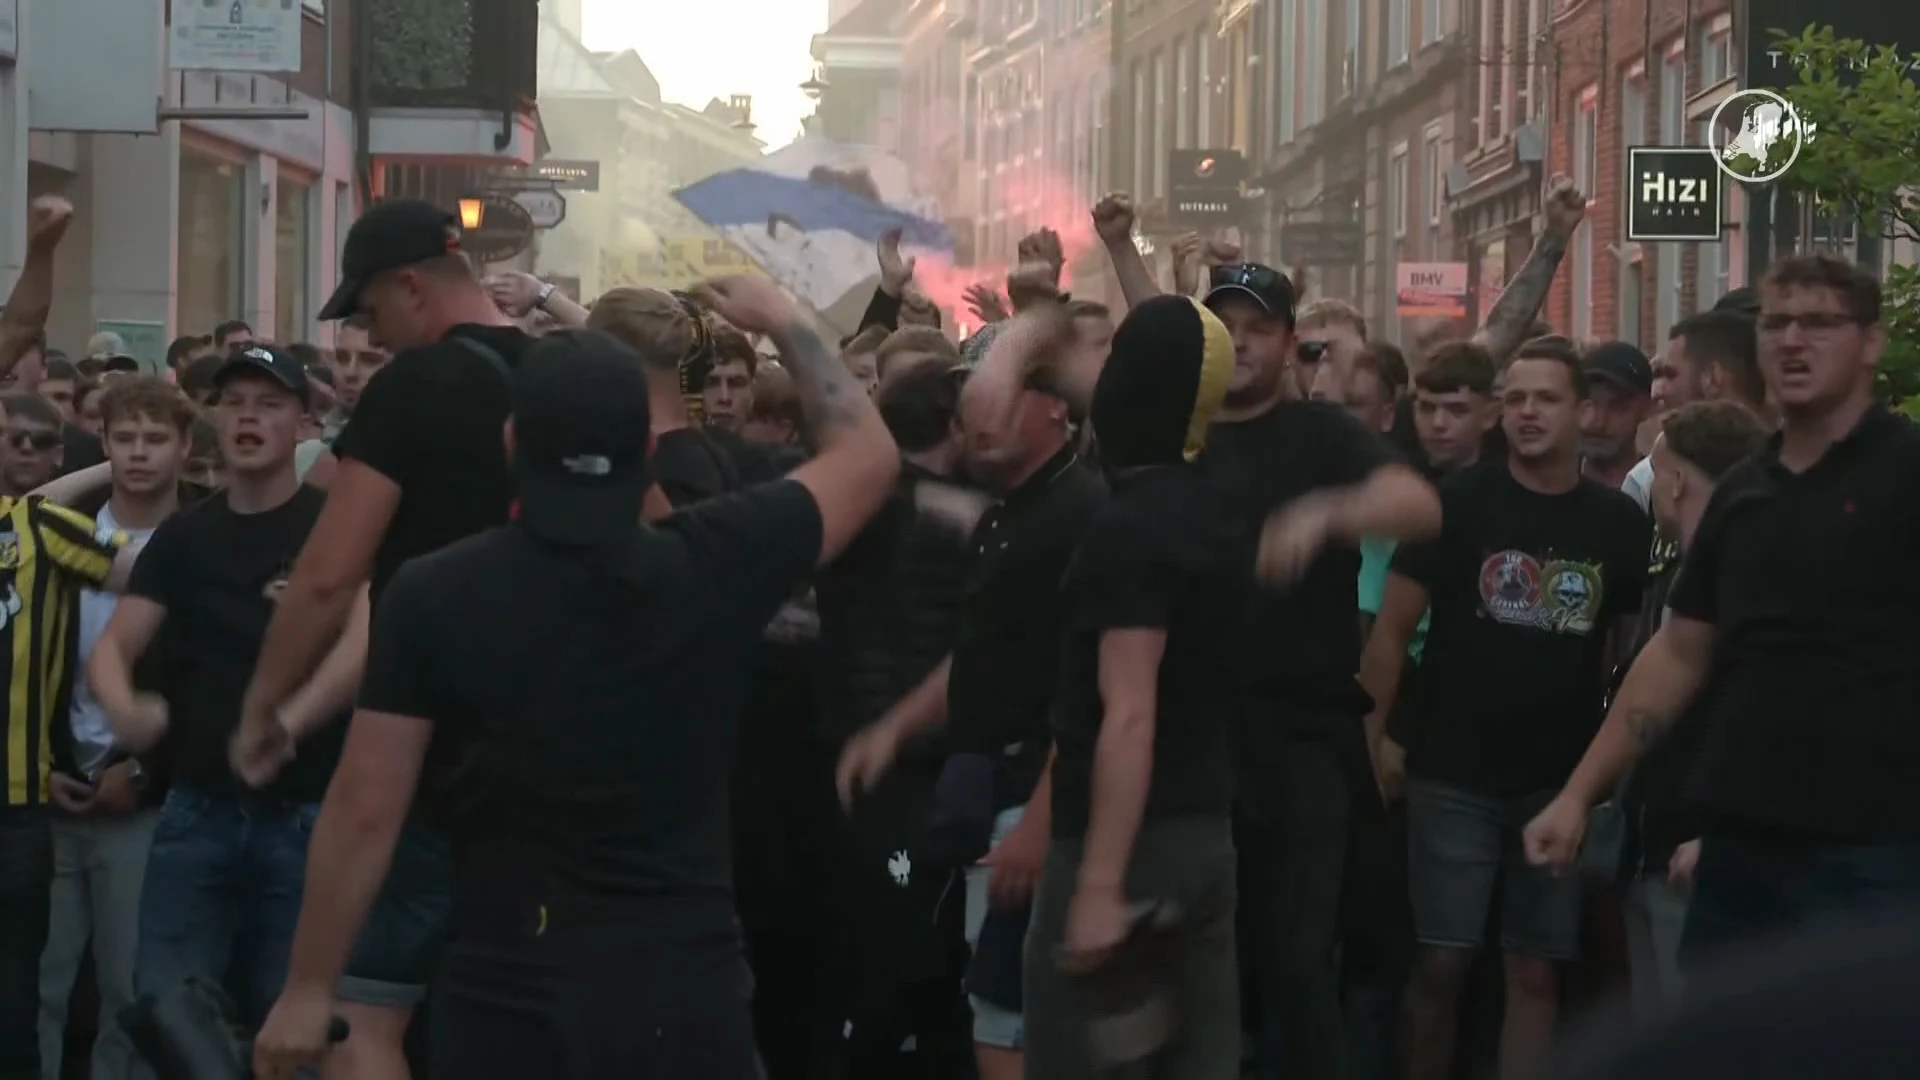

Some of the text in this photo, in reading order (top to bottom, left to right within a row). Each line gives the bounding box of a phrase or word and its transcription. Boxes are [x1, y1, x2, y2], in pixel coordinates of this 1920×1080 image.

[1643, 171, 1707, 202] HIZI
[1652, 207, 1700, 217] HAIR
[1410, 272, 1444, 286] BMV
